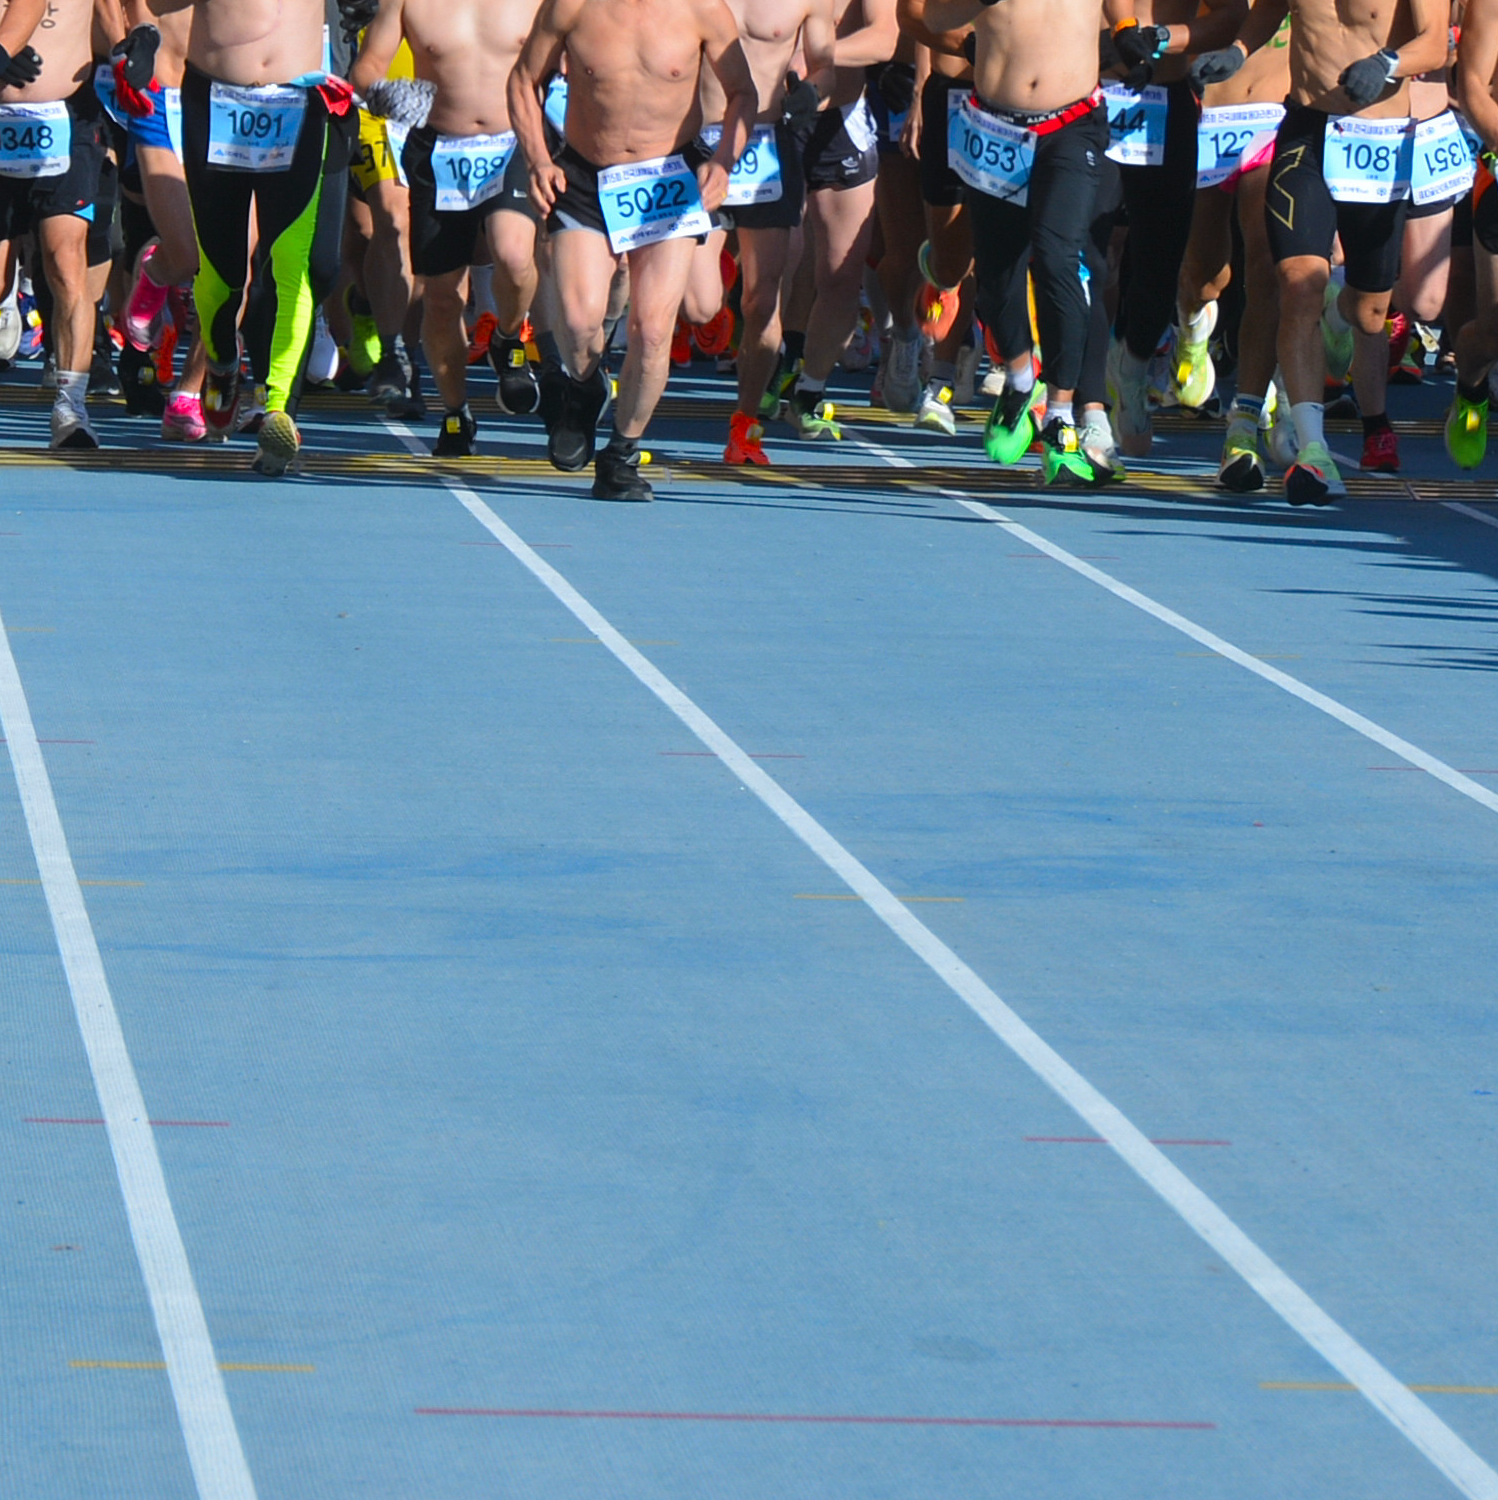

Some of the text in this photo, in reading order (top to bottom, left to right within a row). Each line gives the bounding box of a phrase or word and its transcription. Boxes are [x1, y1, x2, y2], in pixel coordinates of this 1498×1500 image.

[227, 109, 283, 139] 1091
[1110, 108, 1146, 133] 44
[963, 128, 1017, 173] 1053
[1342, 143, 1400, 172] 1081
[617, 180, 689, 219] 5022
